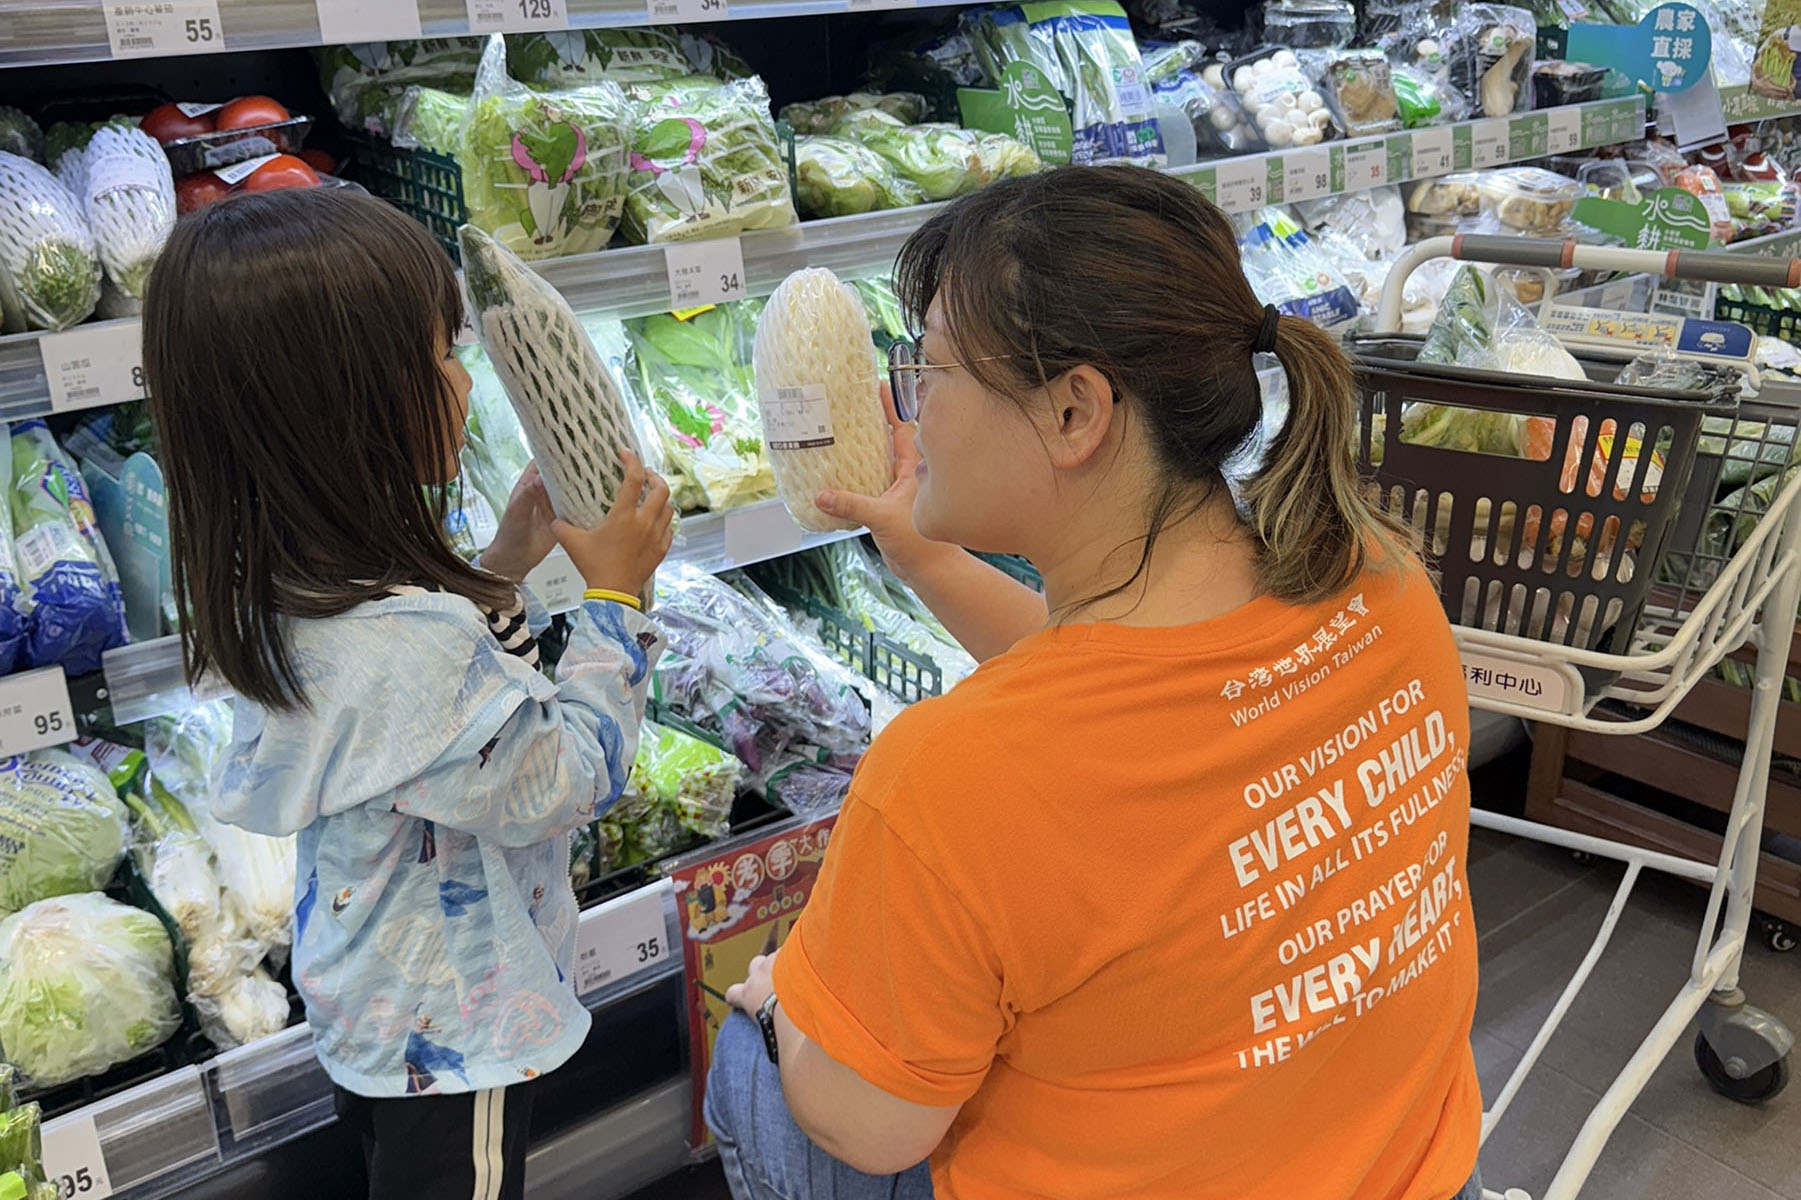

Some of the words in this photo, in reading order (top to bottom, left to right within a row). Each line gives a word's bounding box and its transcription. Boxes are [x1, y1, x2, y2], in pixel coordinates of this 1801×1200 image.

[519, 0, 550, 19] 129
[1654, 9, 1696, 32] 農家
[186, 19, 213, 42] 55
[1651, 36, 1693, 59] 直採
[1250, 186, 1262, 202] 39
[1315, 174, 1327, 189] 98
[720, 273, 739, 293] 34
[1220, 593, 1370, 700] 台灣世界展望會
[1230, 690, 1281, 727] World
[1282, 664, 1330, 702] Vision
[1332, 624, 1383, 669] Taiwan
[35, 711, 63, 735] 95
[1244, 764, 1301, 809] OUR
[1300, 710, 1378, 777] VISION
[1379, 679, 1425, 724] FOR
[1228, 780, 1352, 888] EVERY
[1356, 710, 1455, 808] CHILD,
[1220, 892, 1276, 939] LIFE
[1275, 874, 1305, 910] IN
[1311, 848, 1350, 891] ALL
[1351, 821, 1388, 860] ITS
[1278, 919, 1334, 965] OUR
[1336, 863, 1422, 934] PRAYER
[1421, 831, 1448, 875] FOR
[637, 937, 659, 962] 35
[1250, 937, 1381, 1034] EVERY
[1388, 856, 1462, 964] HEART,
[1233, 1036, 1291, 1069] THE
[1352, 986, 1384, 1017] TO
[1387, 939, 1438, 997] MAKE
[1435, 921, 1453, 953] IT
